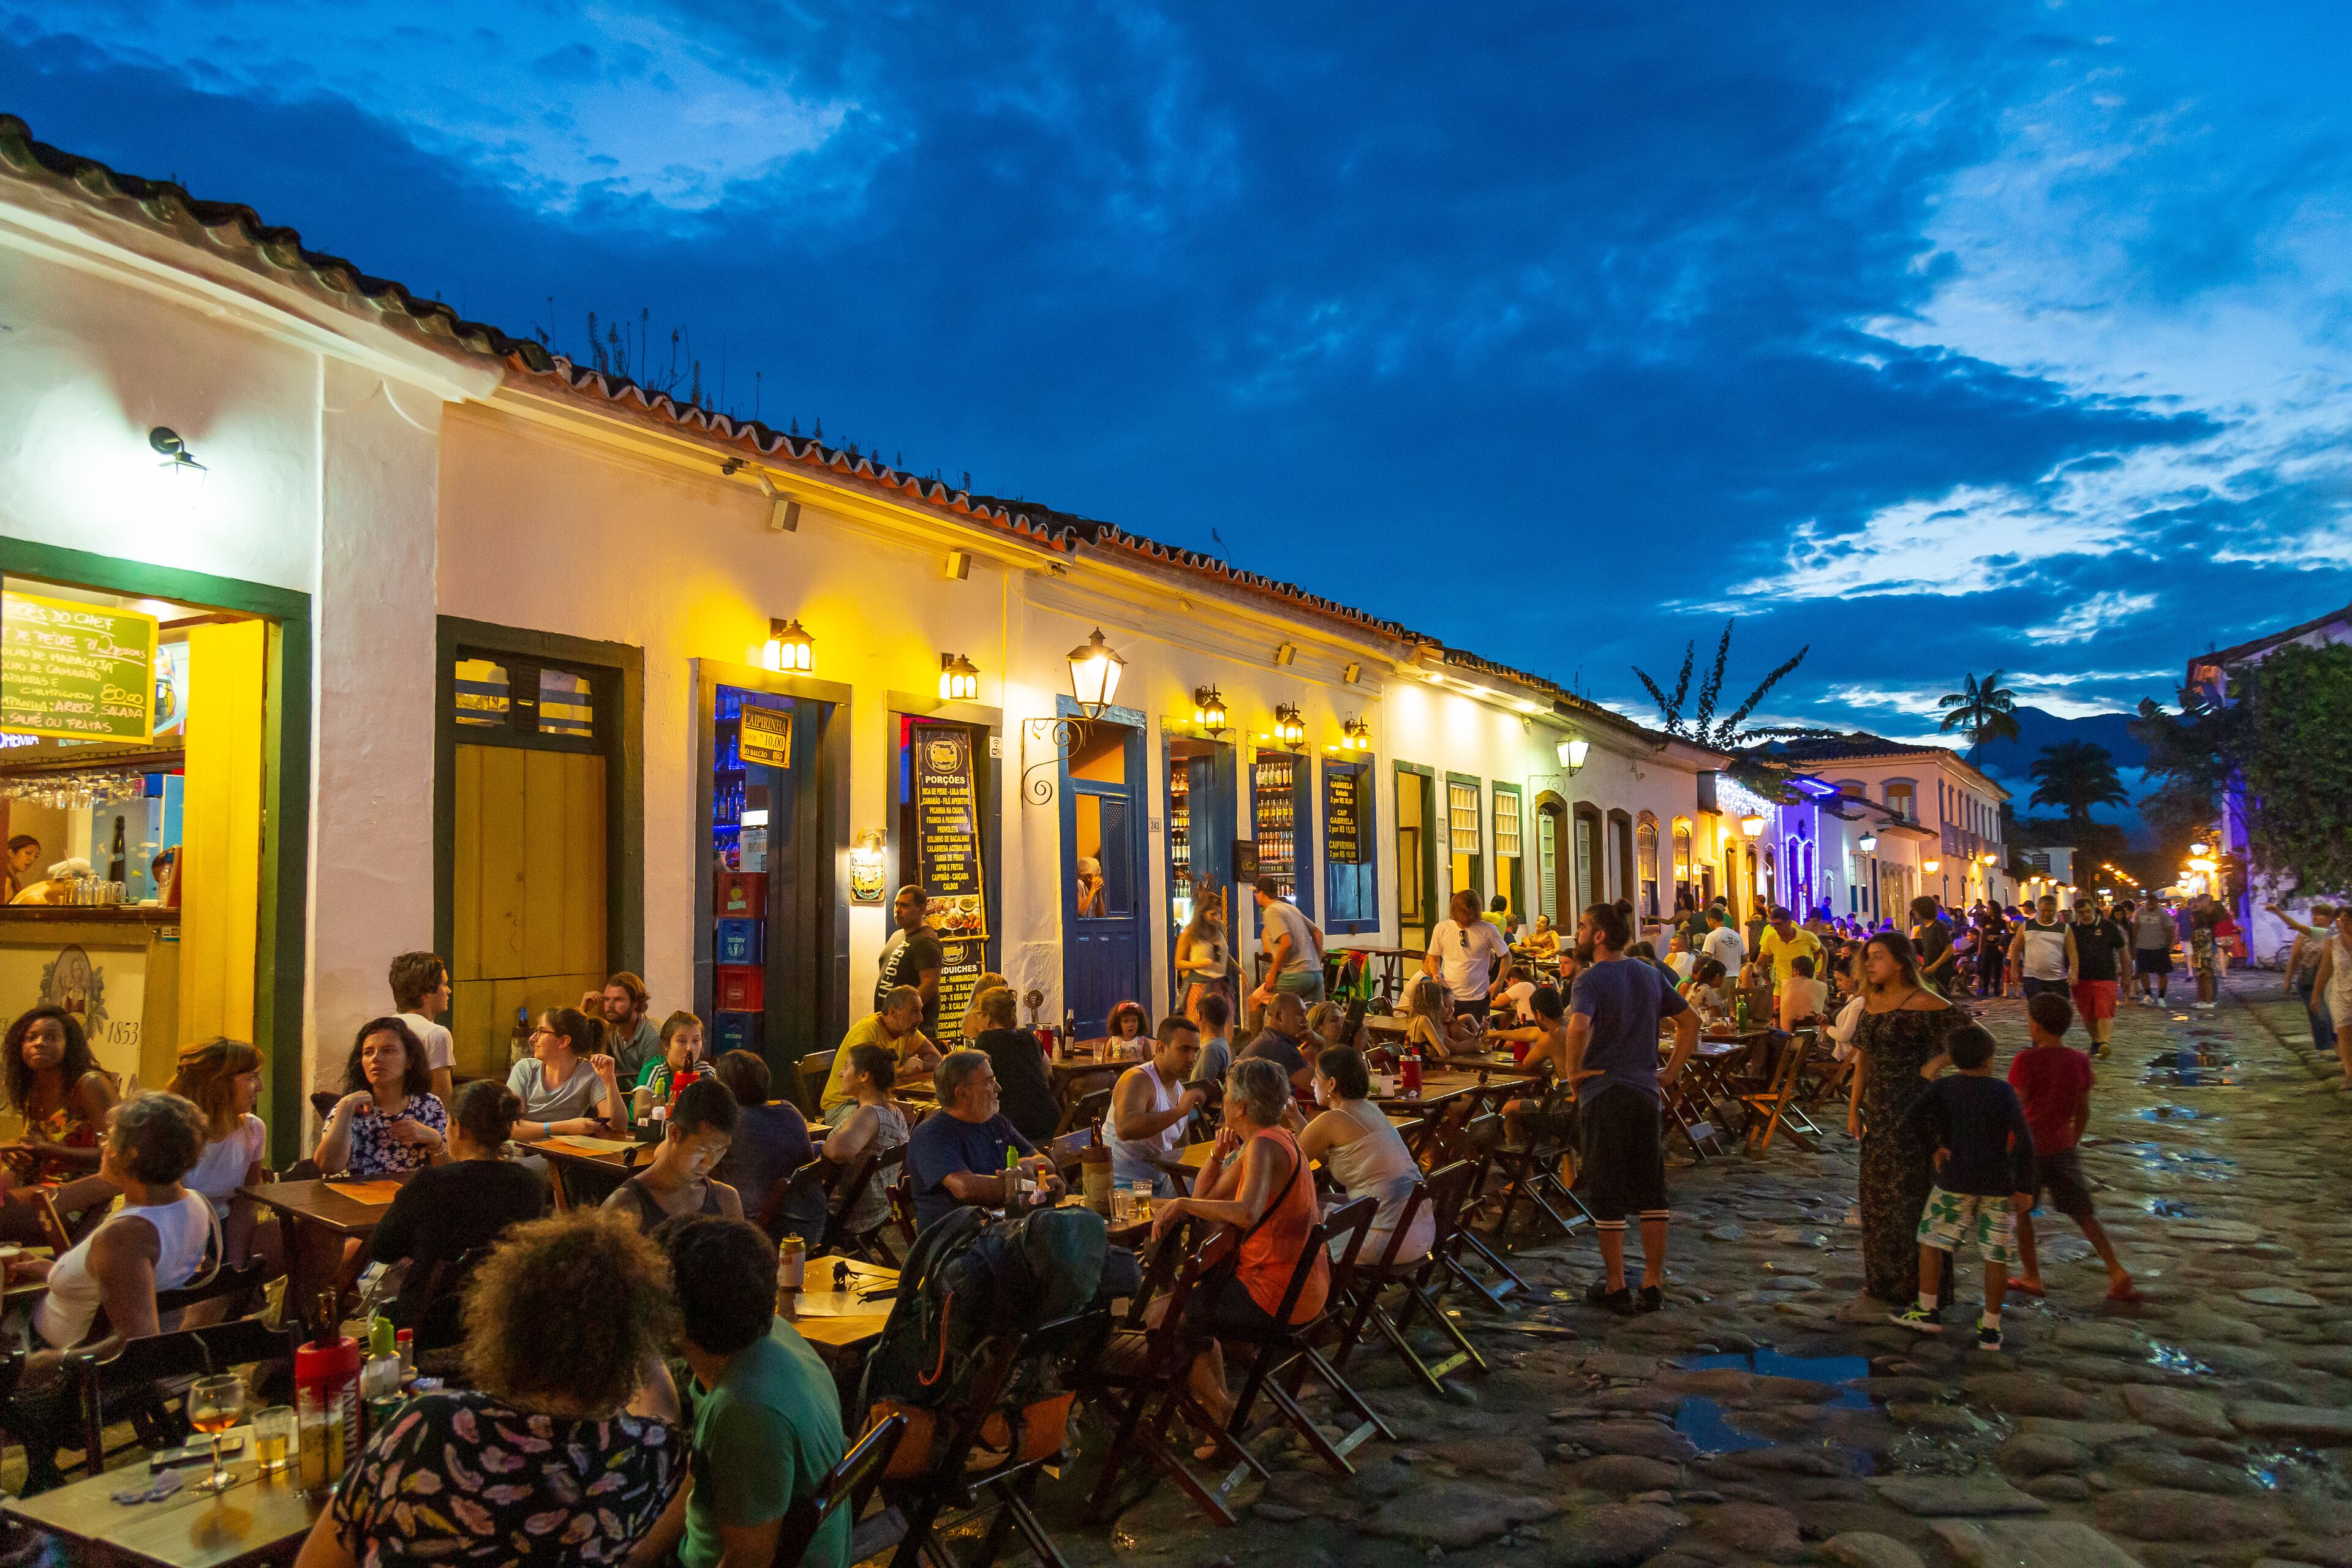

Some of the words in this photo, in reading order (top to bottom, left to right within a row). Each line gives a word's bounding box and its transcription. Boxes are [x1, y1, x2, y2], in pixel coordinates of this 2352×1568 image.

[51, 610, 71, 623] DO
[74, 613, 115, 630] CHEF
[15, 628, 31, 641] DE
[33, 631, 77, 648] PEIXE
[2, 647, 31, 657] OLHO
[32, 649, 47, 661] DE
[29, 663, 42, 673] DE
[47, 665, 101, 681] CAMARÃO
[2, 673, 49, 685] APARRAS
[51, 678, 59, 687] E
[100, 705, 143, 718] SALADA
[46, 717, 62, 728] OU
[66, 718, 113, 733] FRITAS
[745, 713, 786, 733] CAIPIRINHA
[765, 735, 783, 749] 10,00
[750, 749, 767, 758] BALCÃO
[925, 775, 966, 785] PORÇÕES
[1330, 781, 1353, 790] GABRIELA
[922, 796, 940, 805] CAMARÃO
[1150, 821, 1159, 830] 243
[1339, 825, 1345, 834] R$
[1329, 840, 1356, 850] CAIPIRINHA
[934, 853, 947, 862] TÁBUA
[932, 872, 949, 881] CAIPIRÃO
[727, 900, 746, 910] BRAHMA
[941, 965, 978, 974] DUICHES
[949, 974, 979, 983] HAMBURGUER
[938, 1021, 957, 1030] ERICANO
[107, 1022, 139, 1046] 1853
[937, 1030, 957, 1039] ERICANO
